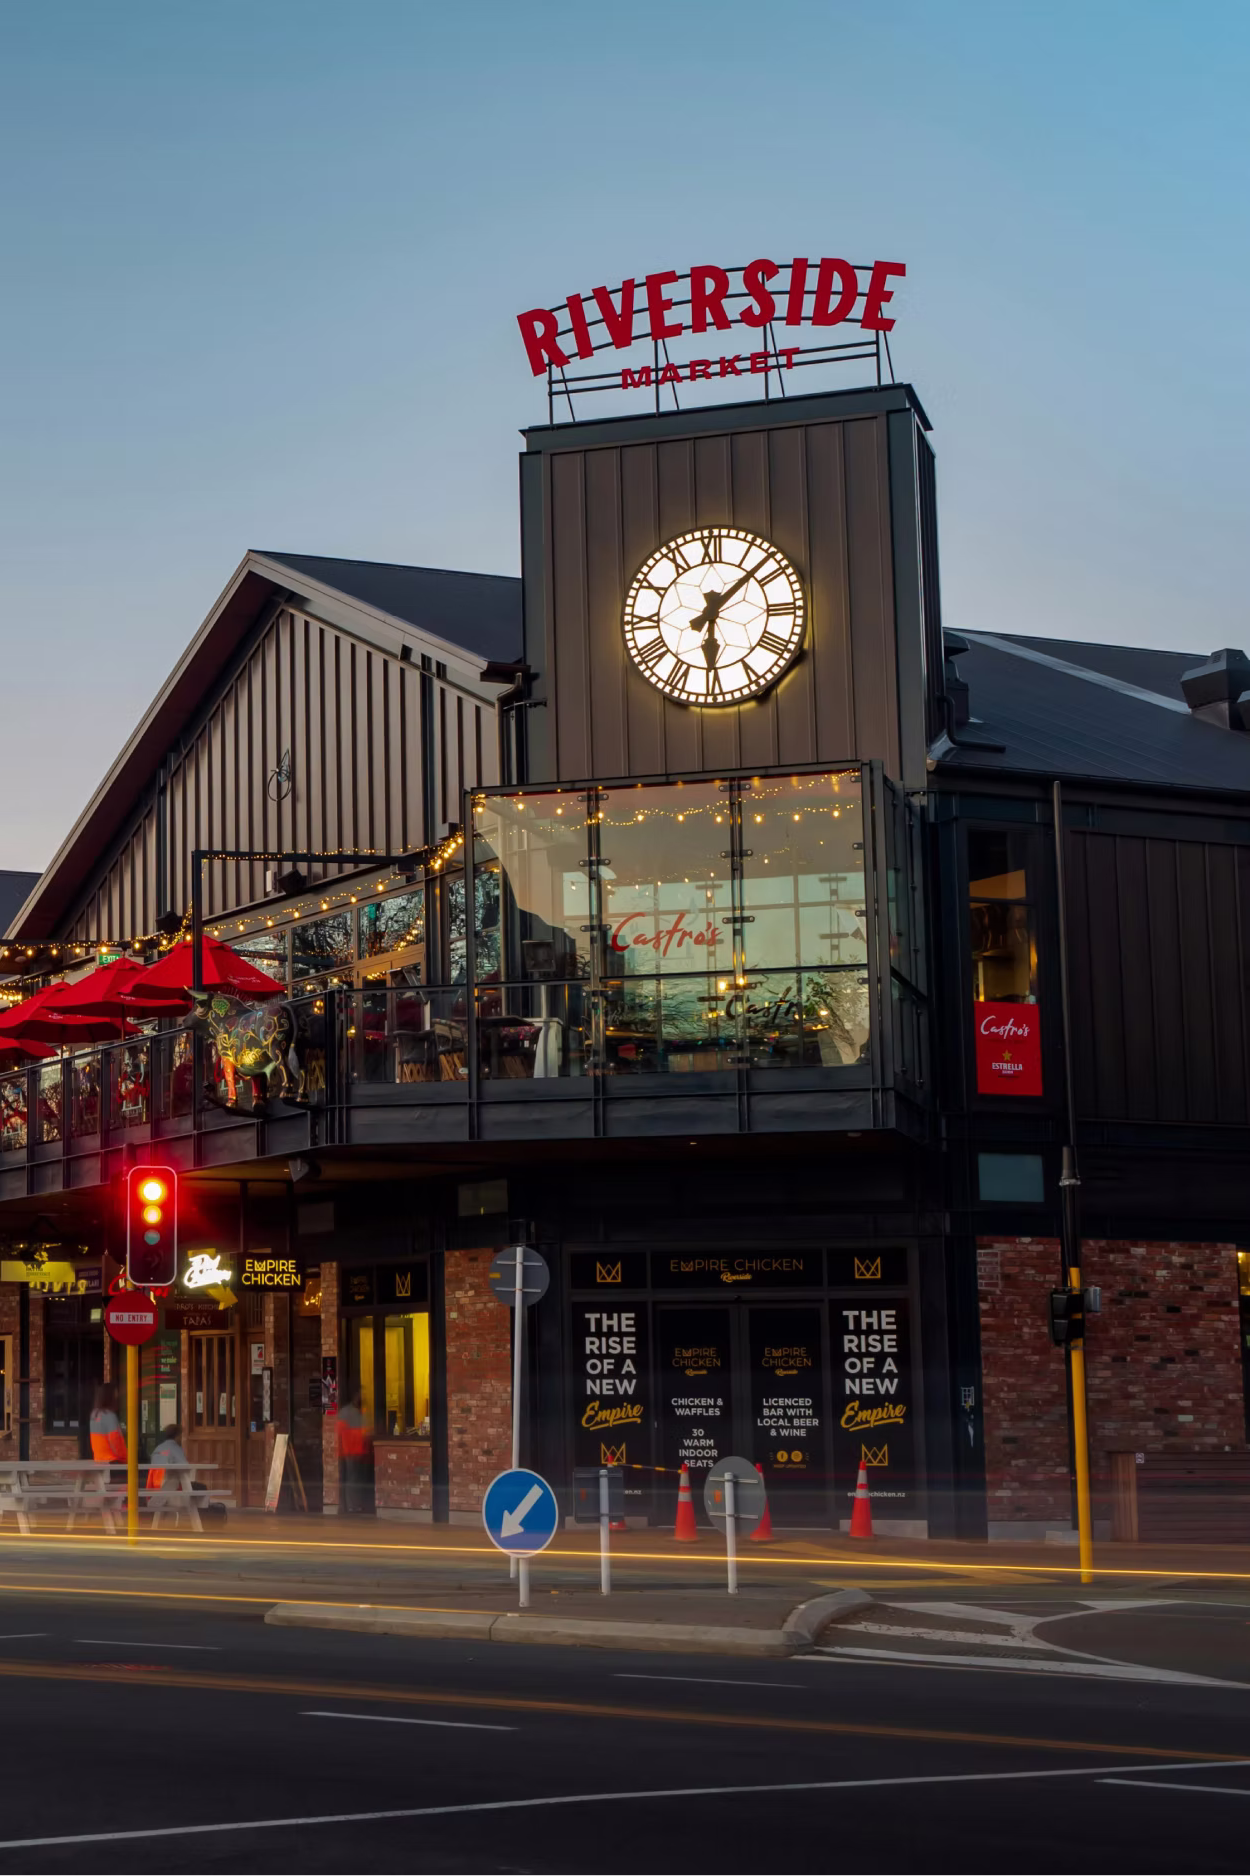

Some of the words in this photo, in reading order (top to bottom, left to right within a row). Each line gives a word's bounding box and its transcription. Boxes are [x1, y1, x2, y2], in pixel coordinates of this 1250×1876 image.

[516, 257, 906, 377] RIVERSIDE
[621, 347, 800, 390] MARKET
[611, 911, 723, 957] Castro's
[980, 1015, 1030, 1039] Castro's
[992, 1062, 1023, 1071] ESTRELLA
[245, 1259, 297, 1273] EMPIRE
[669, 1259, 730, 1272] EMPIRE
[734, 1258, 804, 1271] CHICKEN
[241, 1272, 302, 1286] CHICKEN
[115, 1313, 125, 1322] NO
[127, 1313, 148, 1323] ENTRY
[584, 1312, 637, 1333] THE
[842, 1309, 898, 1331] THE
[584, 1337, 638, 1354] RISE
[843, 1334, 899, 1353] RISE
[675, 1348, 717, 1357] EMPIRE
[764, 1347, 807, 1357] EMPIRE
[585, 1359, 615, 1375] OF
[621, 1359, 637, 1375] A
[672, 1358, 721, 1367] CHICKEN
[761, 1358, 812, 1367] CHICKEN
[844, 1357, 875, 1374] OF
[881, 1357, 899, 1374] A
[586, 1379, 637, 1395] NEW
[845, 1378, 899, 1395] NEW
[671, 1397, 715, 1406] CHICKEN
[716, 1397, 724, 1406] &
[763, 1397, 813, 1406] LICENCED
[581, 1400, 644, 1429] Empire
[675, 1407, 721, 1416] WAFFLES
[763, 1408, 784, 1416] BAR
[786, 1408, 813, 1416] WITH
[840, 1400, 906, 1430] Empire
[757, 1418, 791, 1426] LOCAL
[793, 1418, 819, 1426] BEER
[692, 1428, 705, 1437] 30
[770, 1428, 777, 1437] &
[779, 1428, 807, 1437] WINE
[683, 1439, 714, 1447] WARM
[678, 1449, 718, 1457] INDOOR
[684, 1459, 714, 1468] SEATS
